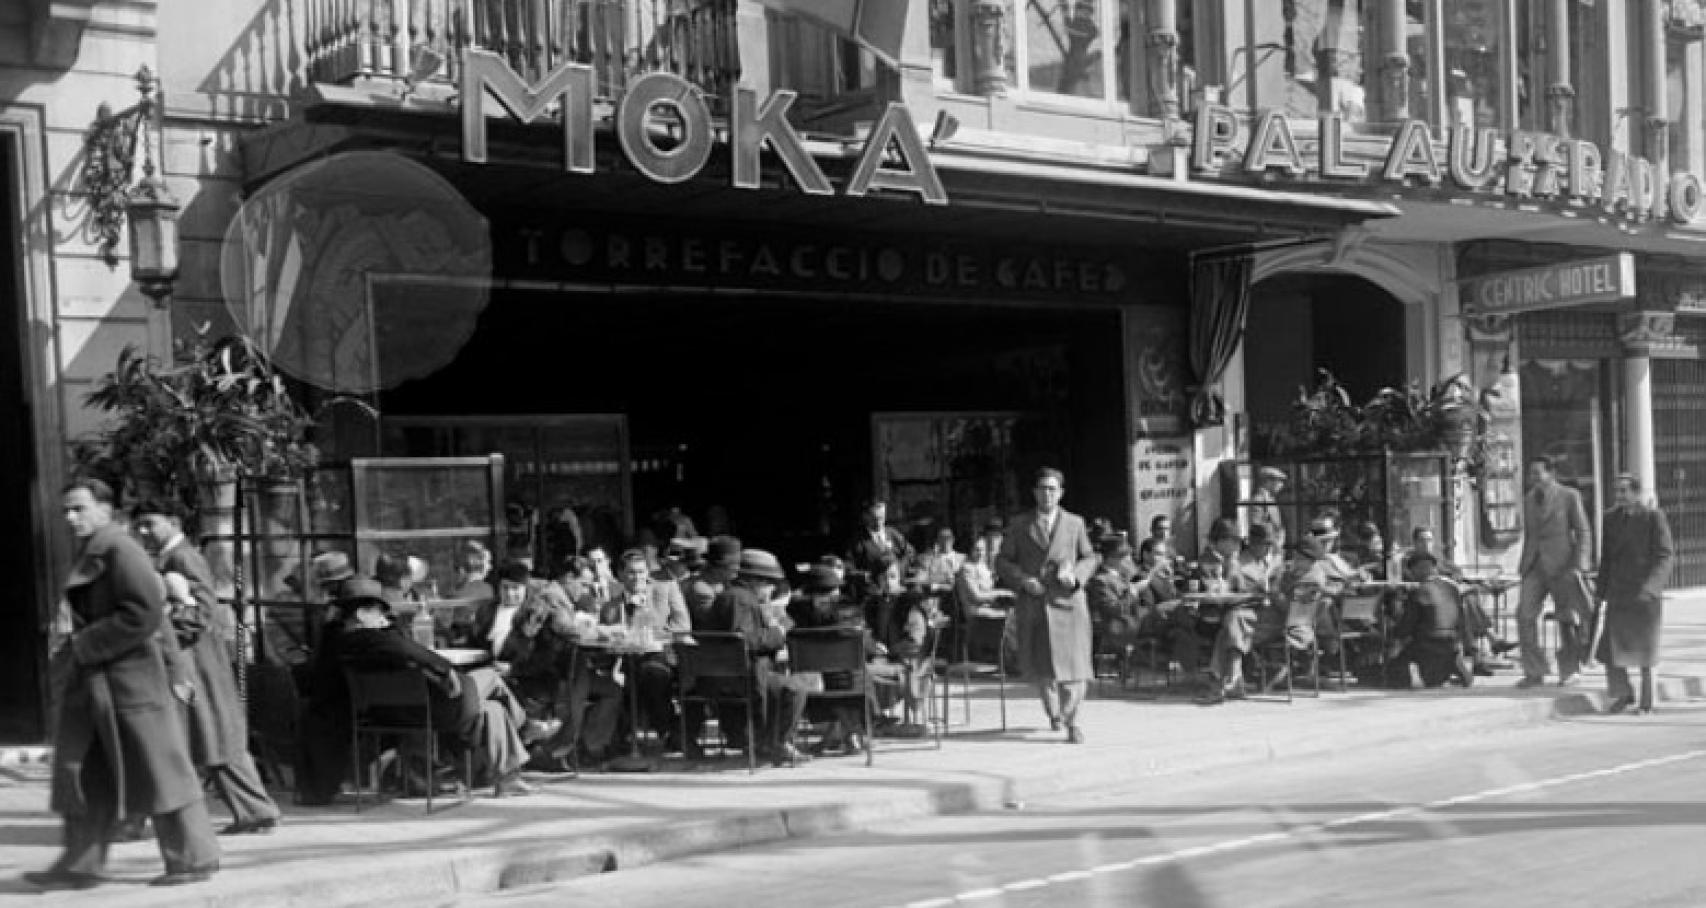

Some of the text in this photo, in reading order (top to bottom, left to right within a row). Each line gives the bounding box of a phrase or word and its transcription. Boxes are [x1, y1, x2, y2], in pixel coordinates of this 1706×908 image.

[464, 46, 949, 206] MOKA
[1192, 102, 1498, 188] PALAU
[1568, 139, 1703, 223] RADIO
[926, 252, 979, 285] DE
[1481, 264, 1617, 307] CENTRIC HOTEL
